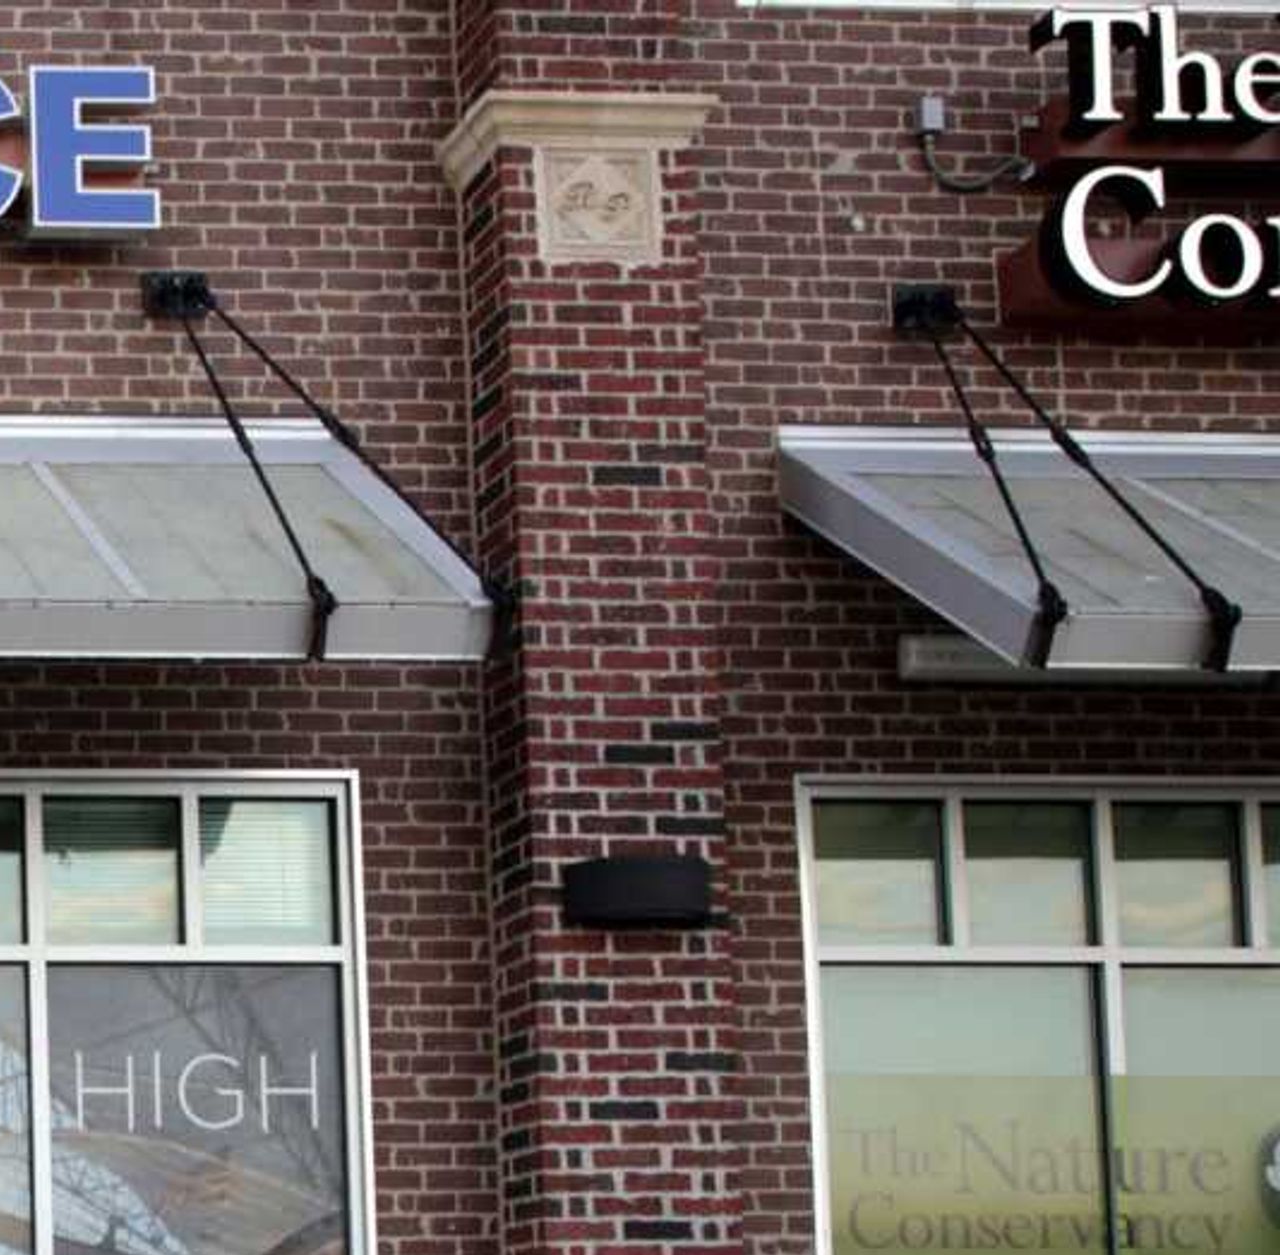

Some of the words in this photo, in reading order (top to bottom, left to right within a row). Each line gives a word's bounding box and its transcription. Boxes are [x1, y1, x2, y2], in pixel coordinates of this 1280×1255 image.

[1052, 3, 1280, 124] The
[1060, 165, 1280, 299] Co
[74, 1050, 319, 1133] HIGH
[837, 1123, 949, 1177] The
[953, 1118, 1233, 1196] Nature
